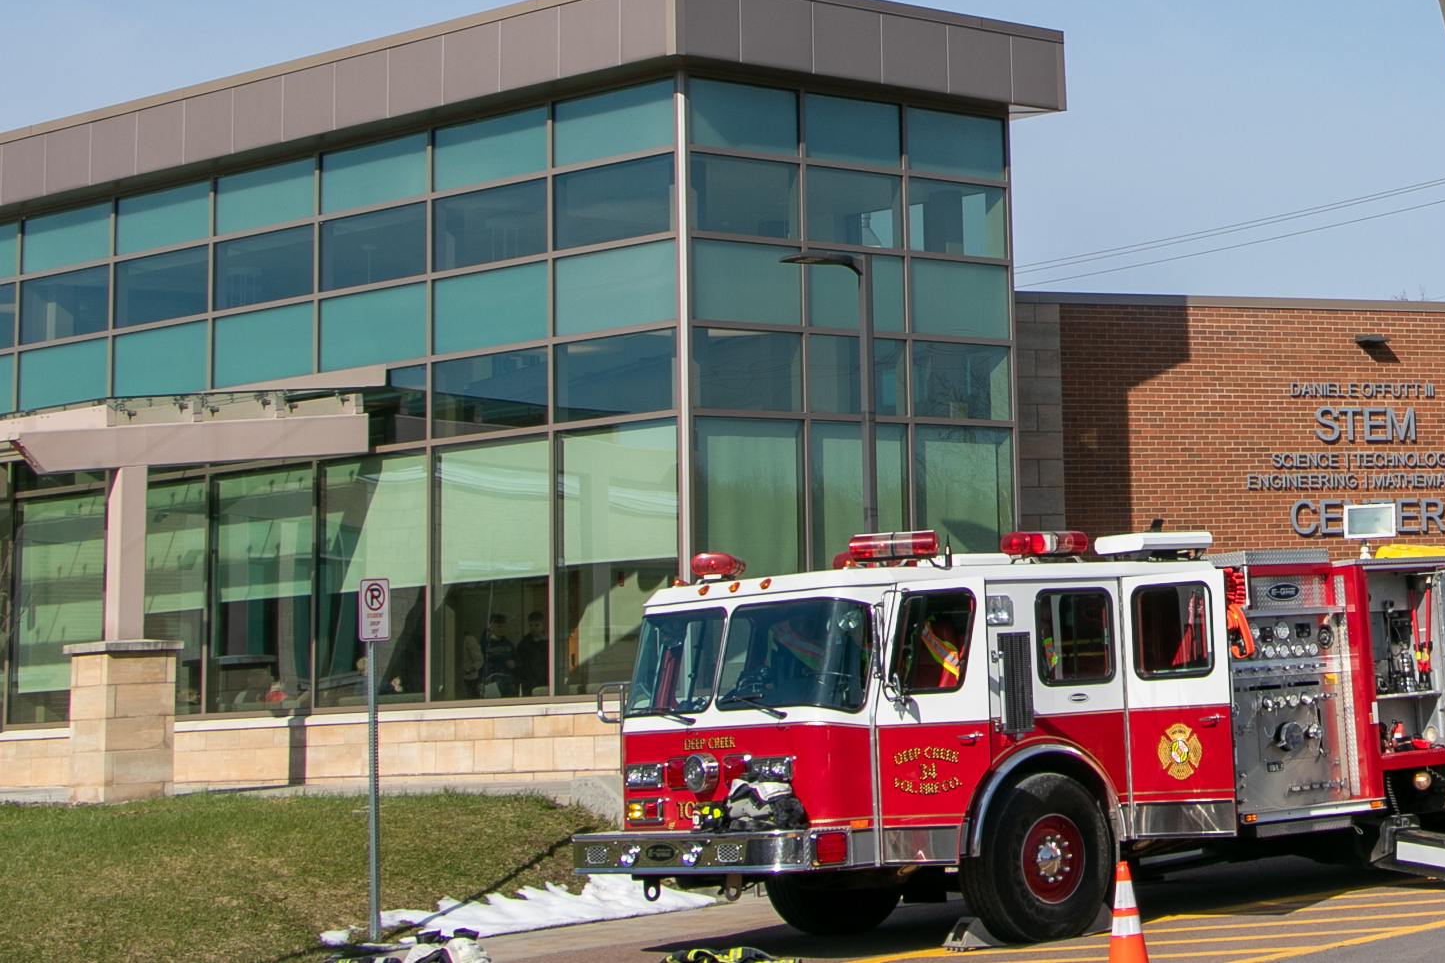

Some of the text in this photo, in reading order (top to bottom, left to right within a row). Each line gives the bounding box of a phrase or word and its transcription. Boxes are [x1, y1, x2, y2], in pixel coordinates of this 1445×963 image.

[1289, 383, 1342, 398] DANIEL
[1349, 383, 1359, 397] E
[1361, 382, 1421, 397] OFFUTT
[1314, 406, 1417, 442] STEM
[1271, 453, 1339, 468] SCIENCE
[1247, 474, 1359, 490] ENGINEERING
[1271, 587, 1296, 596] E-ONE
[683, 737, 736, 751] DEEP CREEK
[893, 746, 960, 766] DEEP CREEK
[919, 763, 938, 780] 34
[919, 782, 940, 795] FIRE
